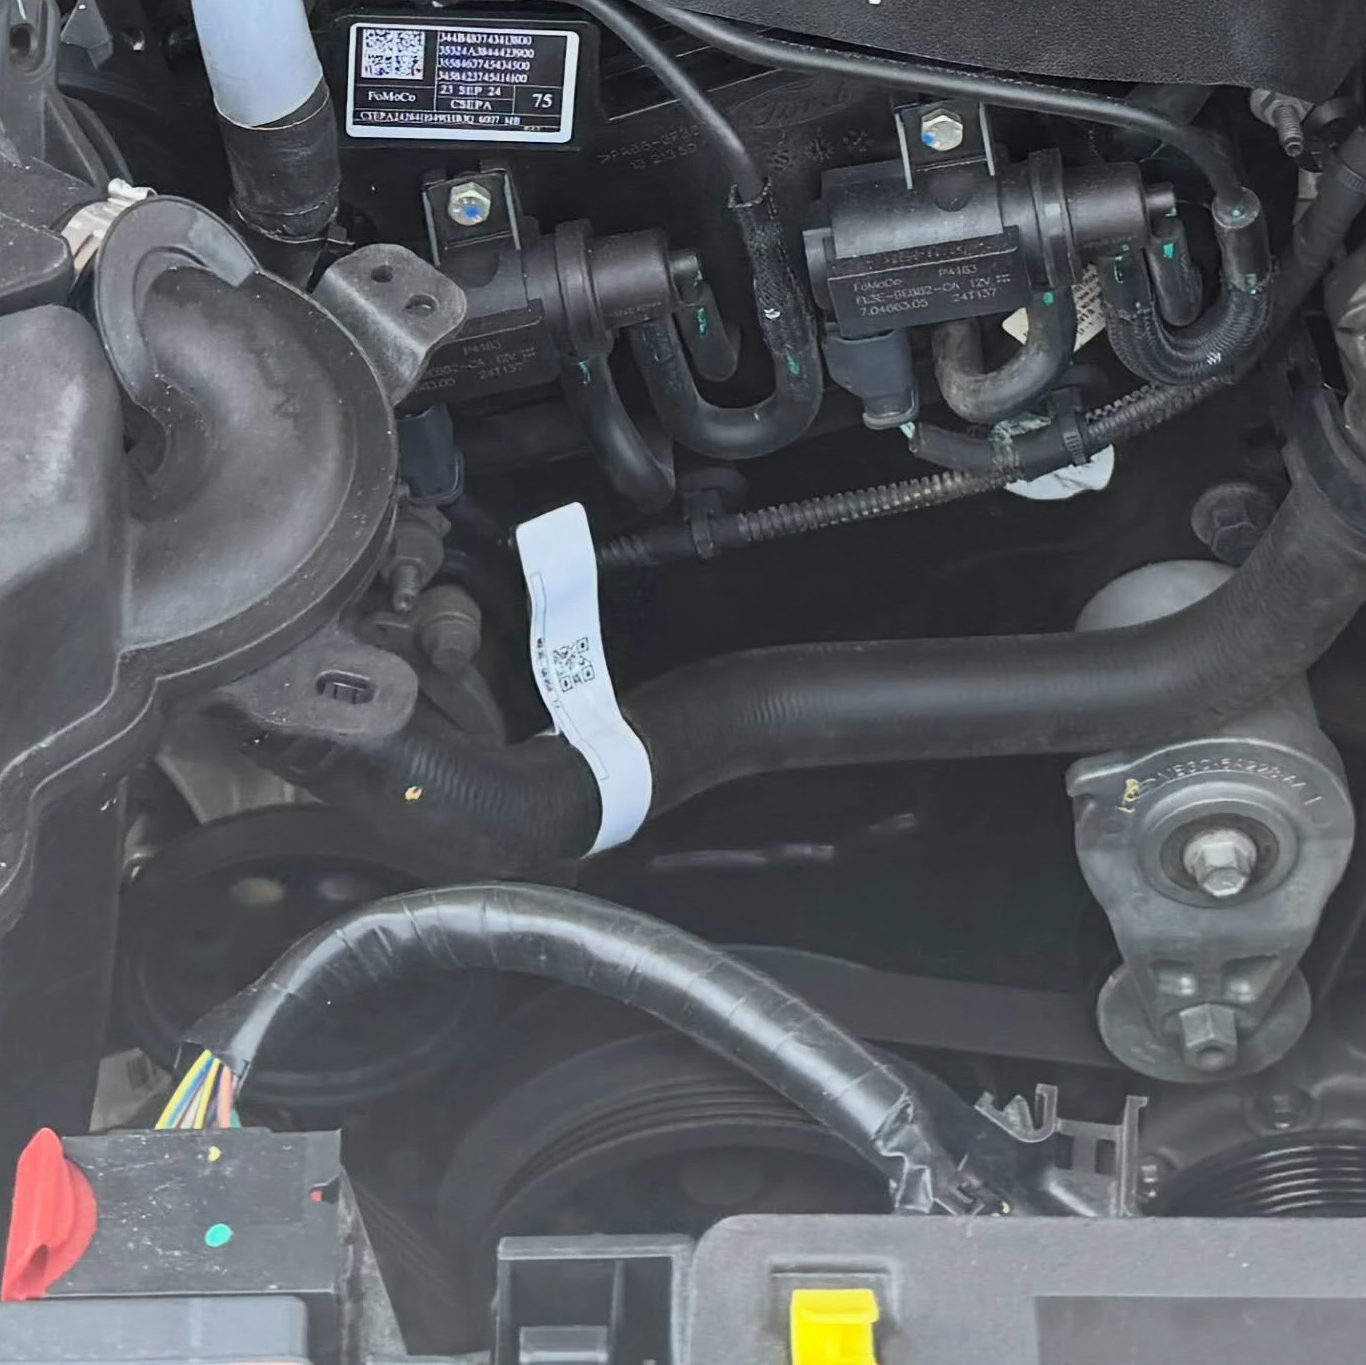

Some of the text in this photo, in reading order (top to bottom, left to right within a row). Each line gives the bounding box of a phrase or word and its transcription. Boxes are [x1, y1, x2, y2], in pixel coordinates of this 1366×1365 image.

[367, 90, 416, 103] FoMoCo
[440, 85, 502, 97] 23 SEP 24
[532, 93, 553, 109] 75
